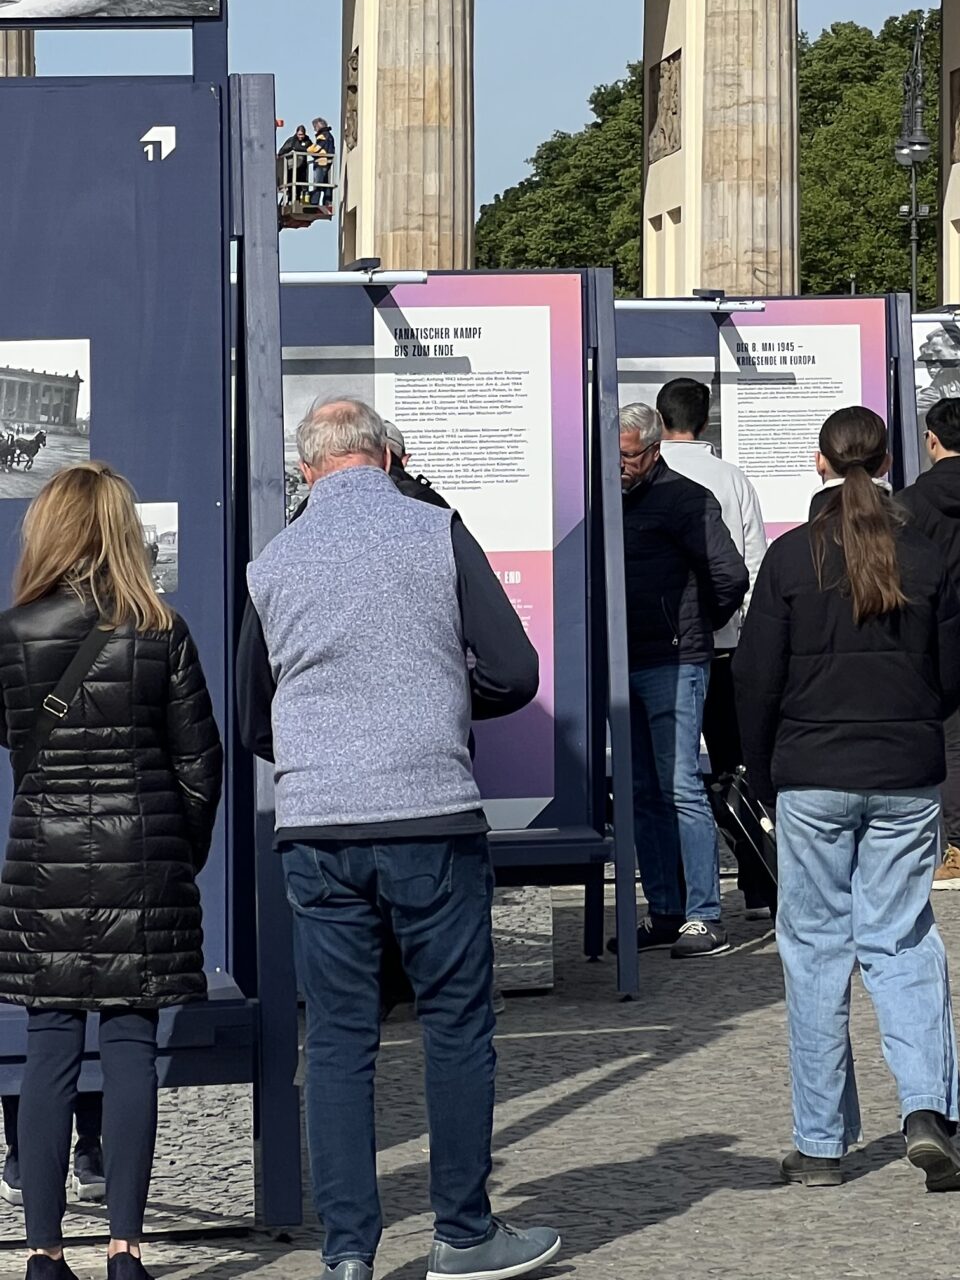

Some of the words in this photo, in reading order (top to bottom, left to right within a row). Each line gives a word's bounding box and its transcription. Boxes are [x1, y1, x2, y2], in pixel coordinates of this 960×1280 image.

[143, 144, 154, 161] 1
[394, 327, 450, 340] FANATISCHER
[453, 327, 482, 339] KAMPF
[394, 345, 409, 357] BIS
[412, 344, 430, 357] ZUM
[433, 344, 454, 356] ENDE
[736, 342, 749, 352] DER
[751, 342, 759, 352] 8.
[761, 342, 775, 351] MAI
[777, 341, 795, 352] 1945
[736, 356, 777, 366] KRIEGSENDE
[779, 355, 788, 365] IN
[789, 355, 816, 365] EUROPA
